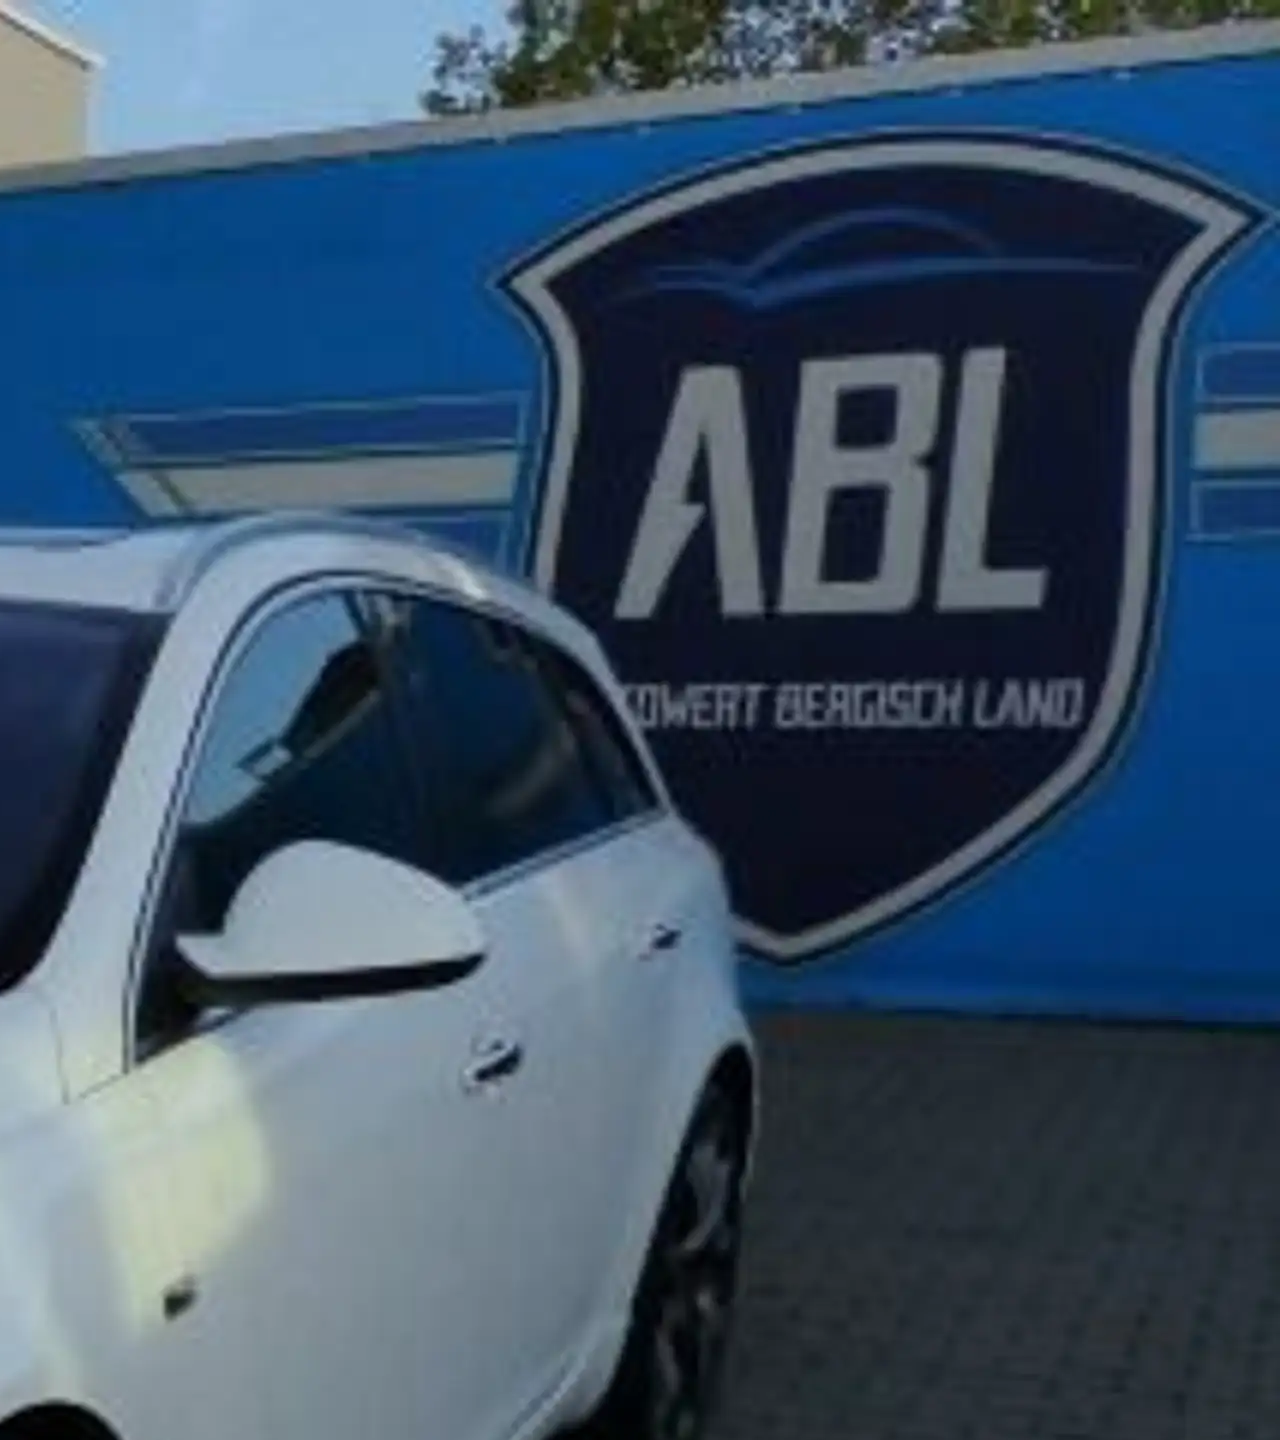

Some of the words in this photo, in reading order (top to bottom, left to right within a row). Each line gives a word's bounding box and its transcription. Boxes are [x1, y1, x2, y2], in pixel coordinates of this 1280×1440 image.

[614, 347, 1049, 620] ABL
[775, 677, 963, 729] BERGISCH
[974, 676, 1083, 729] LAND
